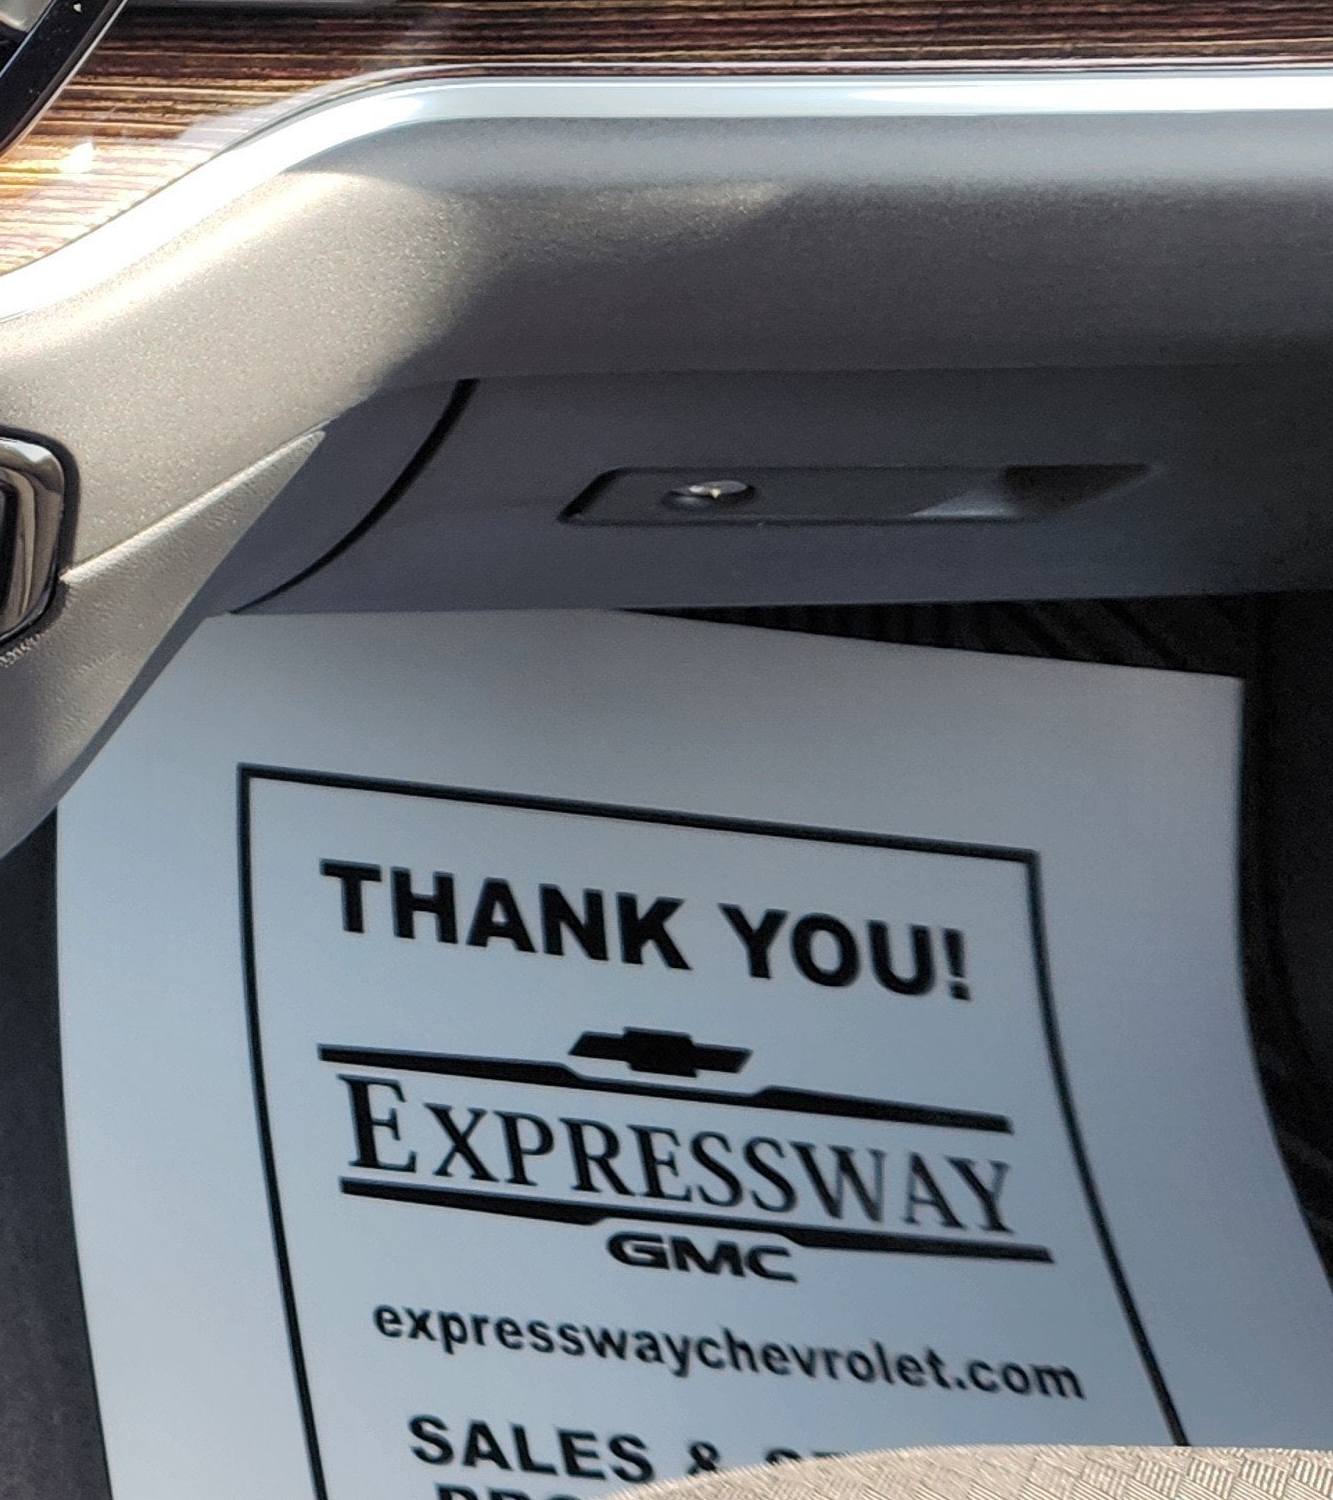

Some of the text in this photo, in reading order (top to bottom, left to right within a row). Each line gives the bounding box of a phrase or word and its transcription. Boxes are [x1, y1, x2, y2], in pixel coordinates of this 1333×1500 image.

[319, 858, 973, 1001] THANK YOU!
[337, 1073, 1017, 1235] EXPRESSWAY
[606, 1230, 799, 1284] GMC
[373, 1302, 1087, 1401] expresswaychevrolet.com
[407, 1413, 655, 1485] SALES
